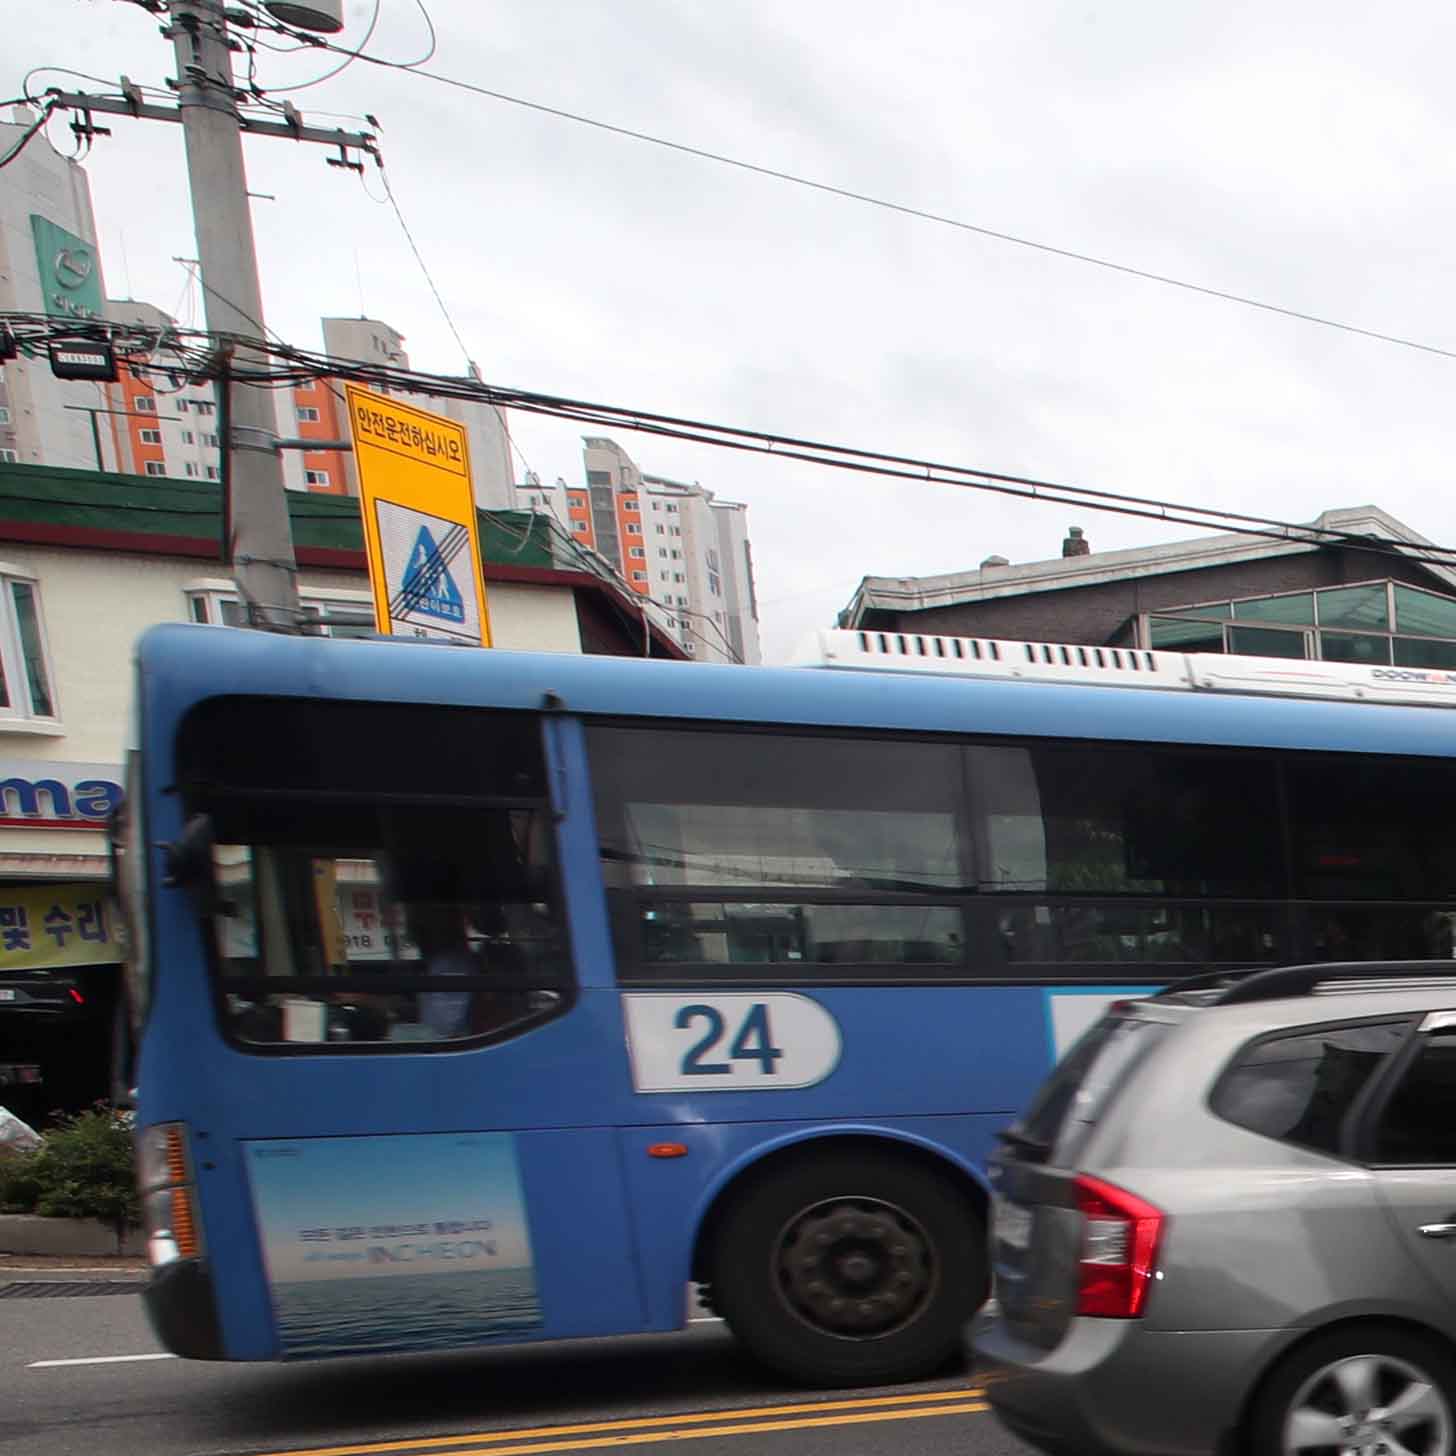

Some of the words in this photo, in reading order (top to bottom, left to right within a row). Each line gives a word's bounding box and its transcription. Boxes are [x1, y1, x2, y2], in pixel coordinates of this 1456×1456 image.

[357, 406, 462, 463] 안전운전하십시오
[43, 902, 108, 948] 수리
[673, 1003, 784, 1075] 24
